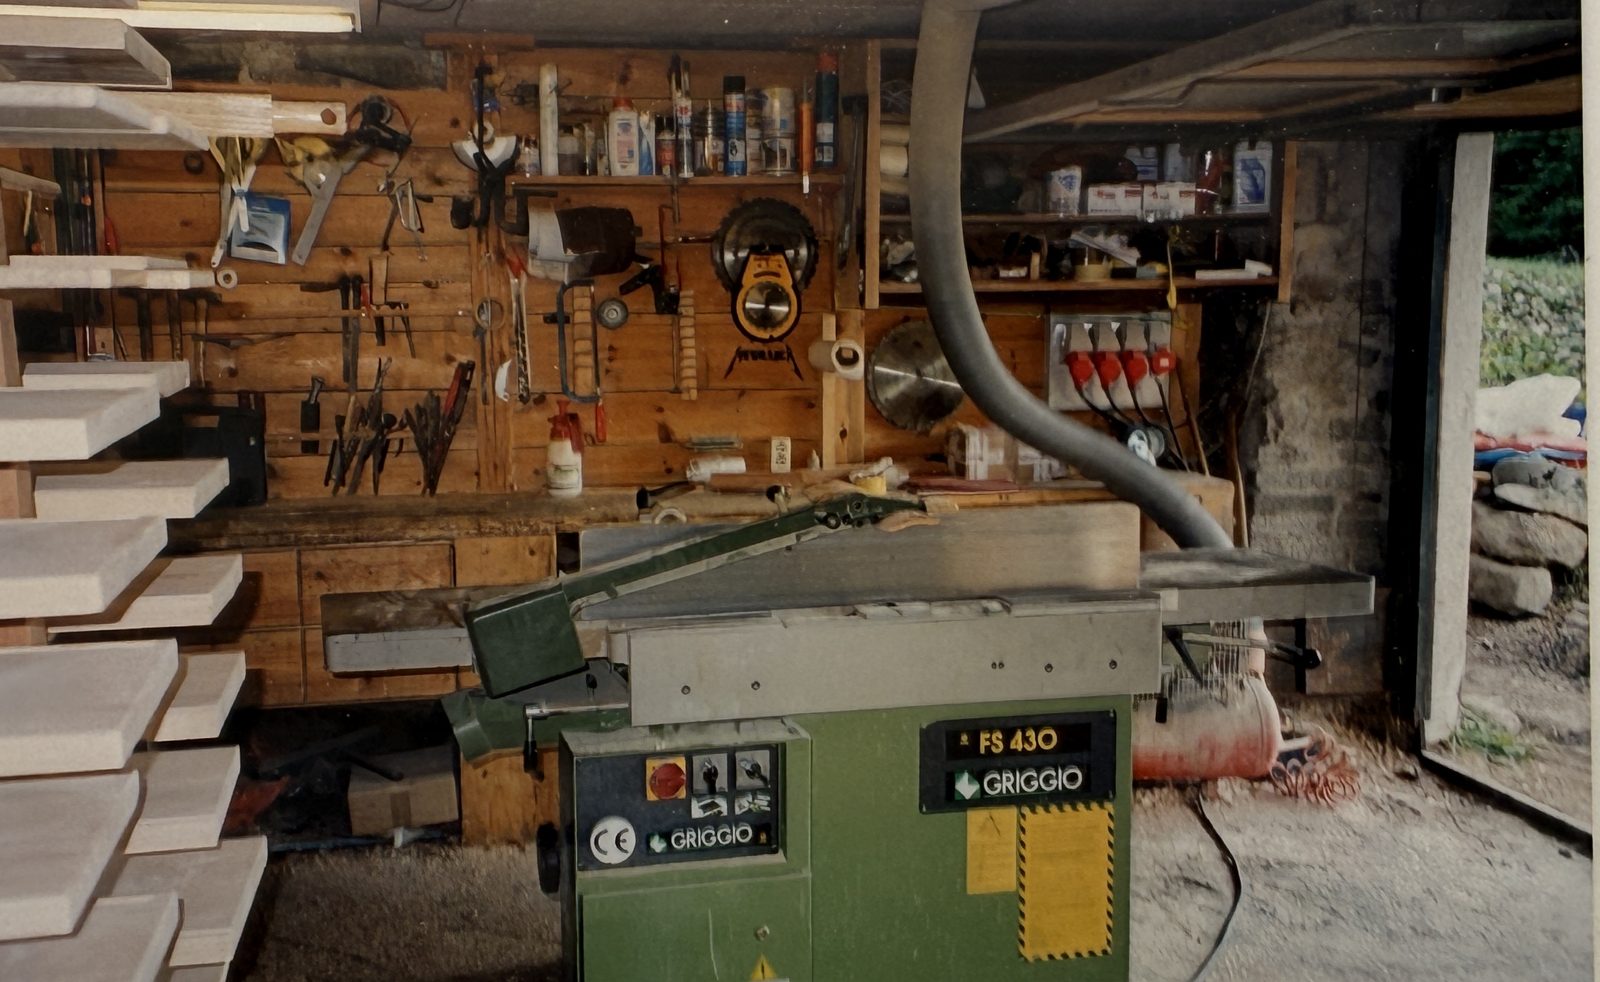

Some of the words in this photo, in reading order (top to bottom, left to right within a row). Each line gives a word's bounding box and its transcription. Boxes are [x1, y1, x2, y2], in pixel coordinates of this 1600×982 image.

[980, 729, 1004, 755] FS
[1009, 726, 1058, 752] 430
[983, 765, 1083, 796] GRIGGIO
[593, 827, 630, 856] CE
[671, 822, 753, 850] GRIGGIO
